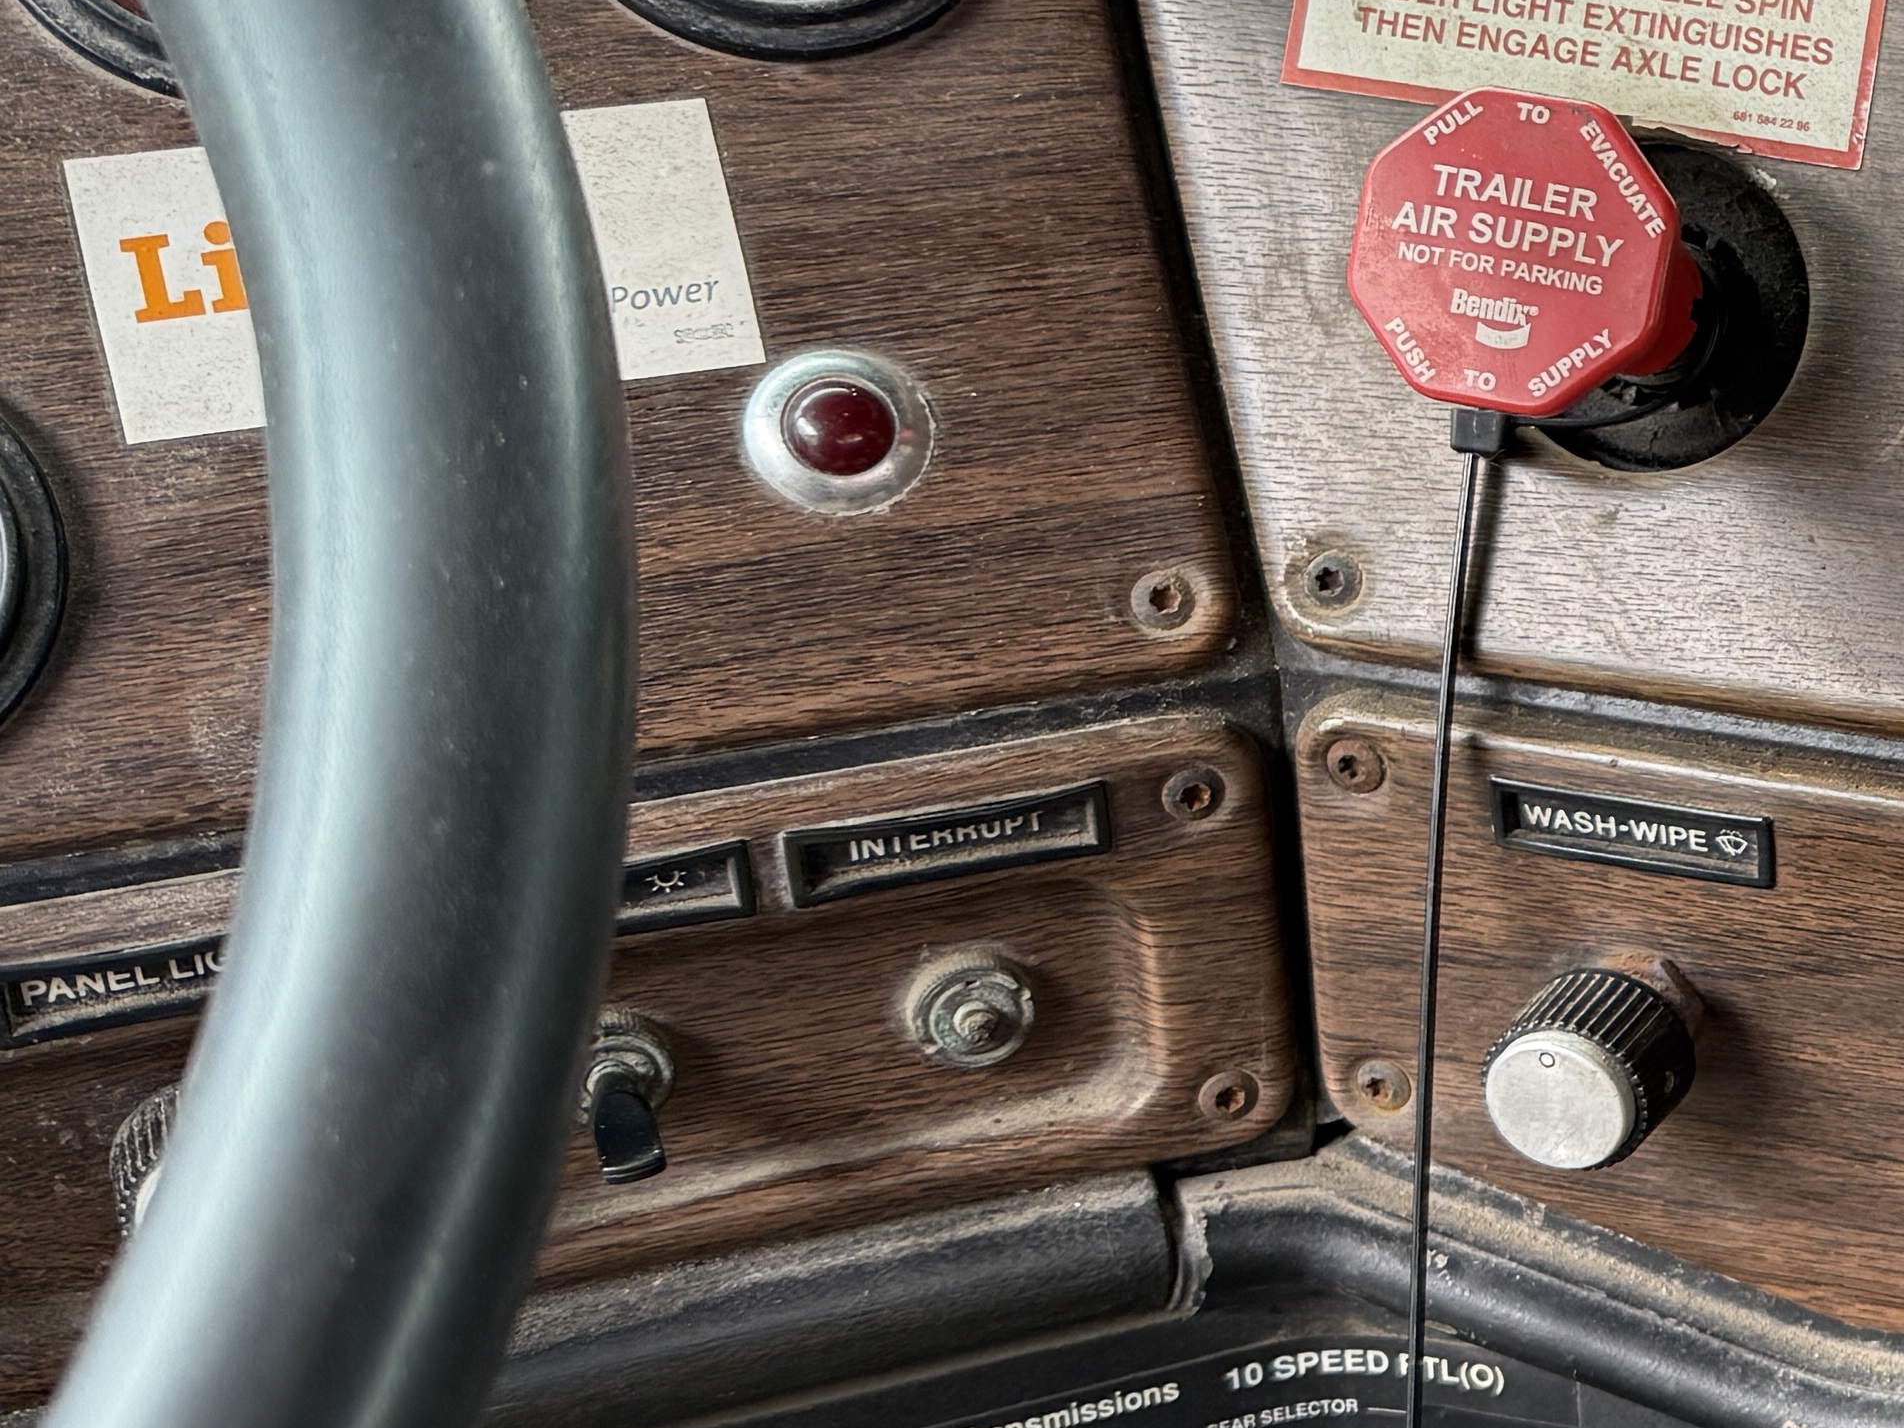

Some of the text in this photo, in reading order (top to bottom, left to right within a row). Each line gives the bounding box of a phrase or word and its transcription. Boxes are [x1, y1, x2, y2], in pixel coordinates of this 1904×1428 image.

[1358, 6, 1809, 100] THEN ENGAGE AXLE LOCK
[1583, 2, 1834, 65] EXTINGUISHES
[1423, 99, 1667, 240] PULL TO EVACUATE
[1432, 163, 1599, 222] TRAILER
[1391, 200, 1625, 269] AIR SUPPLY
[1397, 241, 1605, 296] NOT FOR PARKING
[1384, 316, 1615, 399] PUSH TO SUPPLY
[850, 810, 1045, 862] INTERRUPT
[1521, 801, 1710, 854] WASH-WIPE
[19, 965, 161, 1007] PANEL
[1226, 1348, 1390, 1391] 10 SPEED
[1260, 1397, 1359, 1426] SELECTOR
